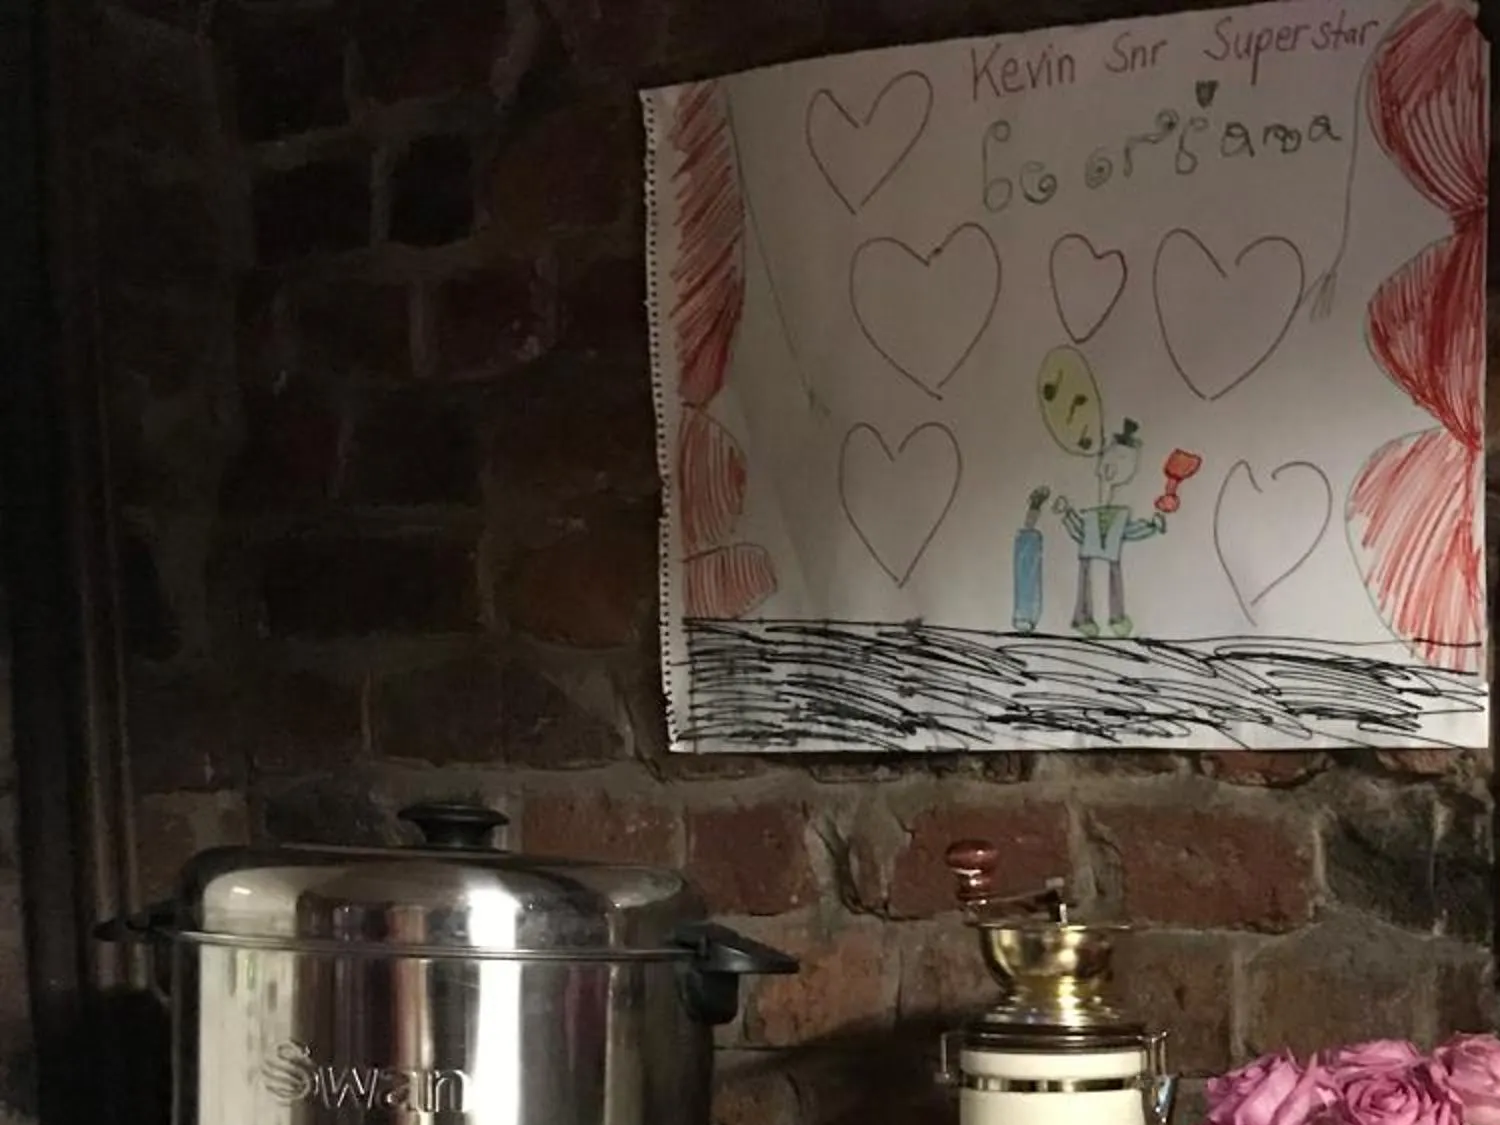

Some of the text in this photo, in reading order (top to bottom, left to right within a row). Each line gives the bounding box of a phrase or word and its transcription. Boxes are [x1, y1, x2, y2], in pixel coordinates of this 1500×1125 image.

[971, 43, 1076, 101] Kevin
[1104, 31, 1168, 73] Snr
[261, 1038, 467, 1114] Swan
